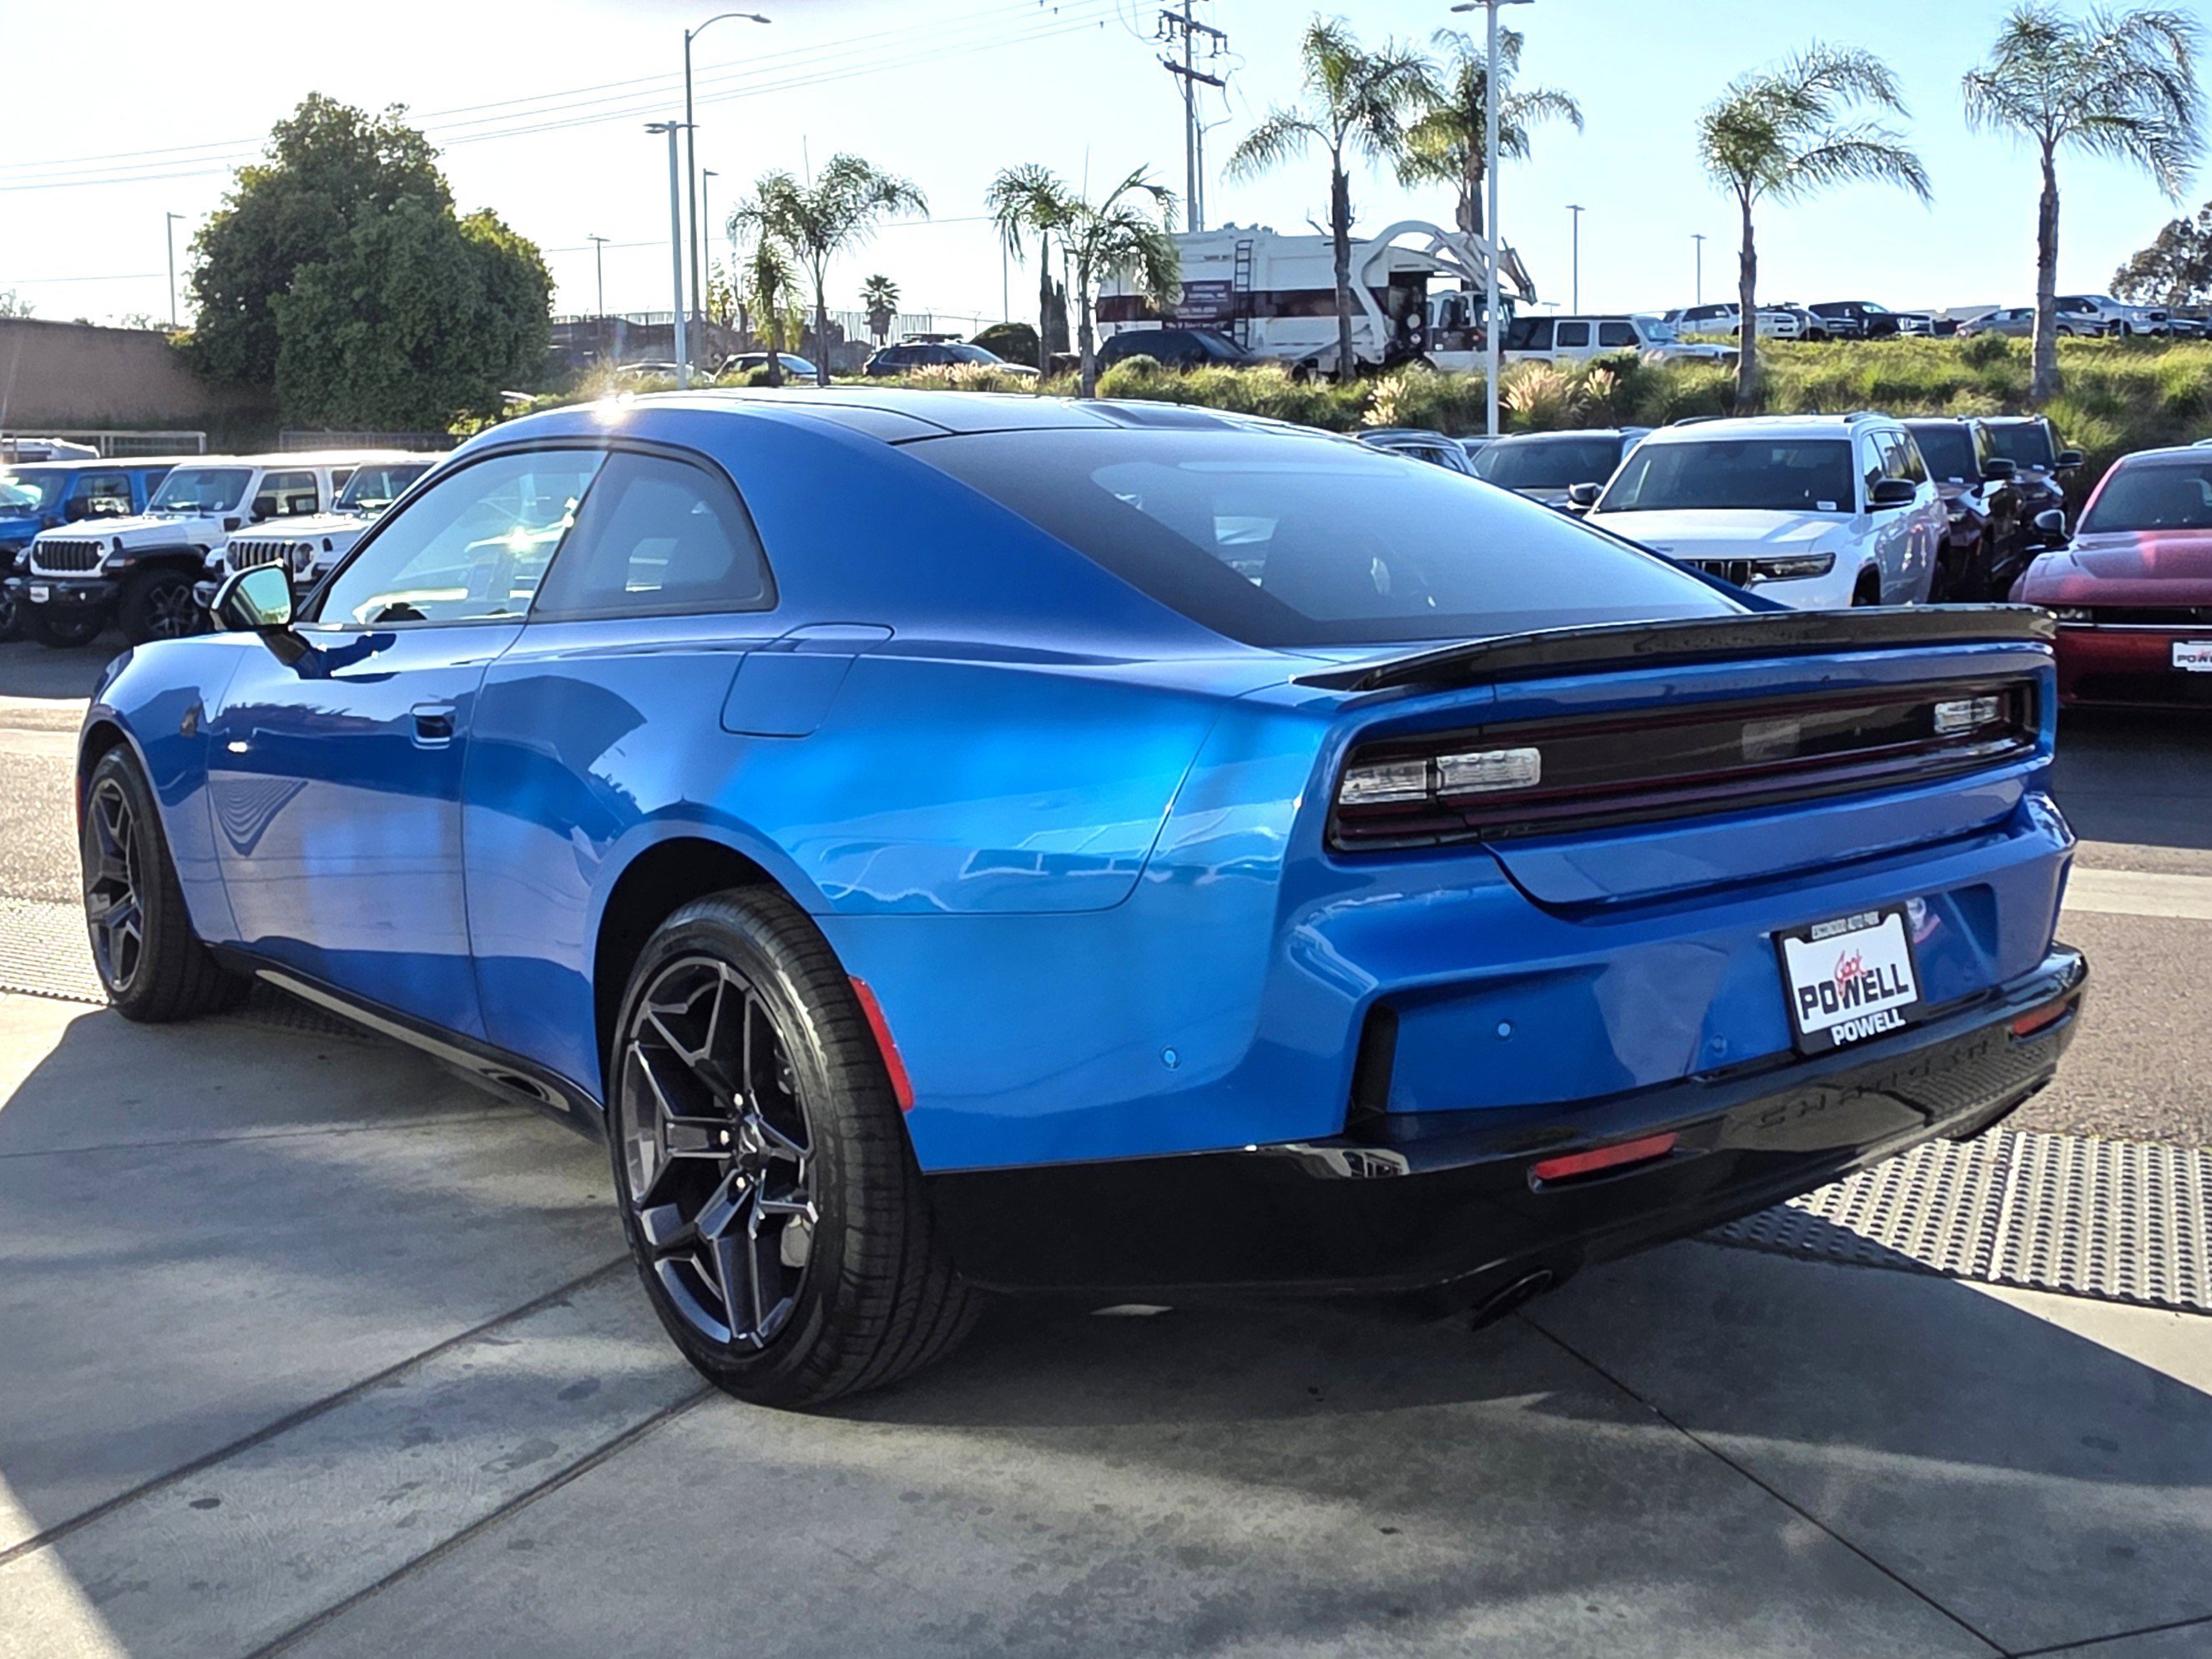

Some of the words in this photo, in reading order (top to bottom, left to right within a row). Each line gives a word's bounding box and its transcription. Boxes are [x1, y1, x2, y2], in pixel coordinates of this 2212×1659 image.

[2177, 654, 2212, 663] POW
[1798, 963, 1909, 1021] POWELL
[1831, 1008, 1906, 1046] POWELL
